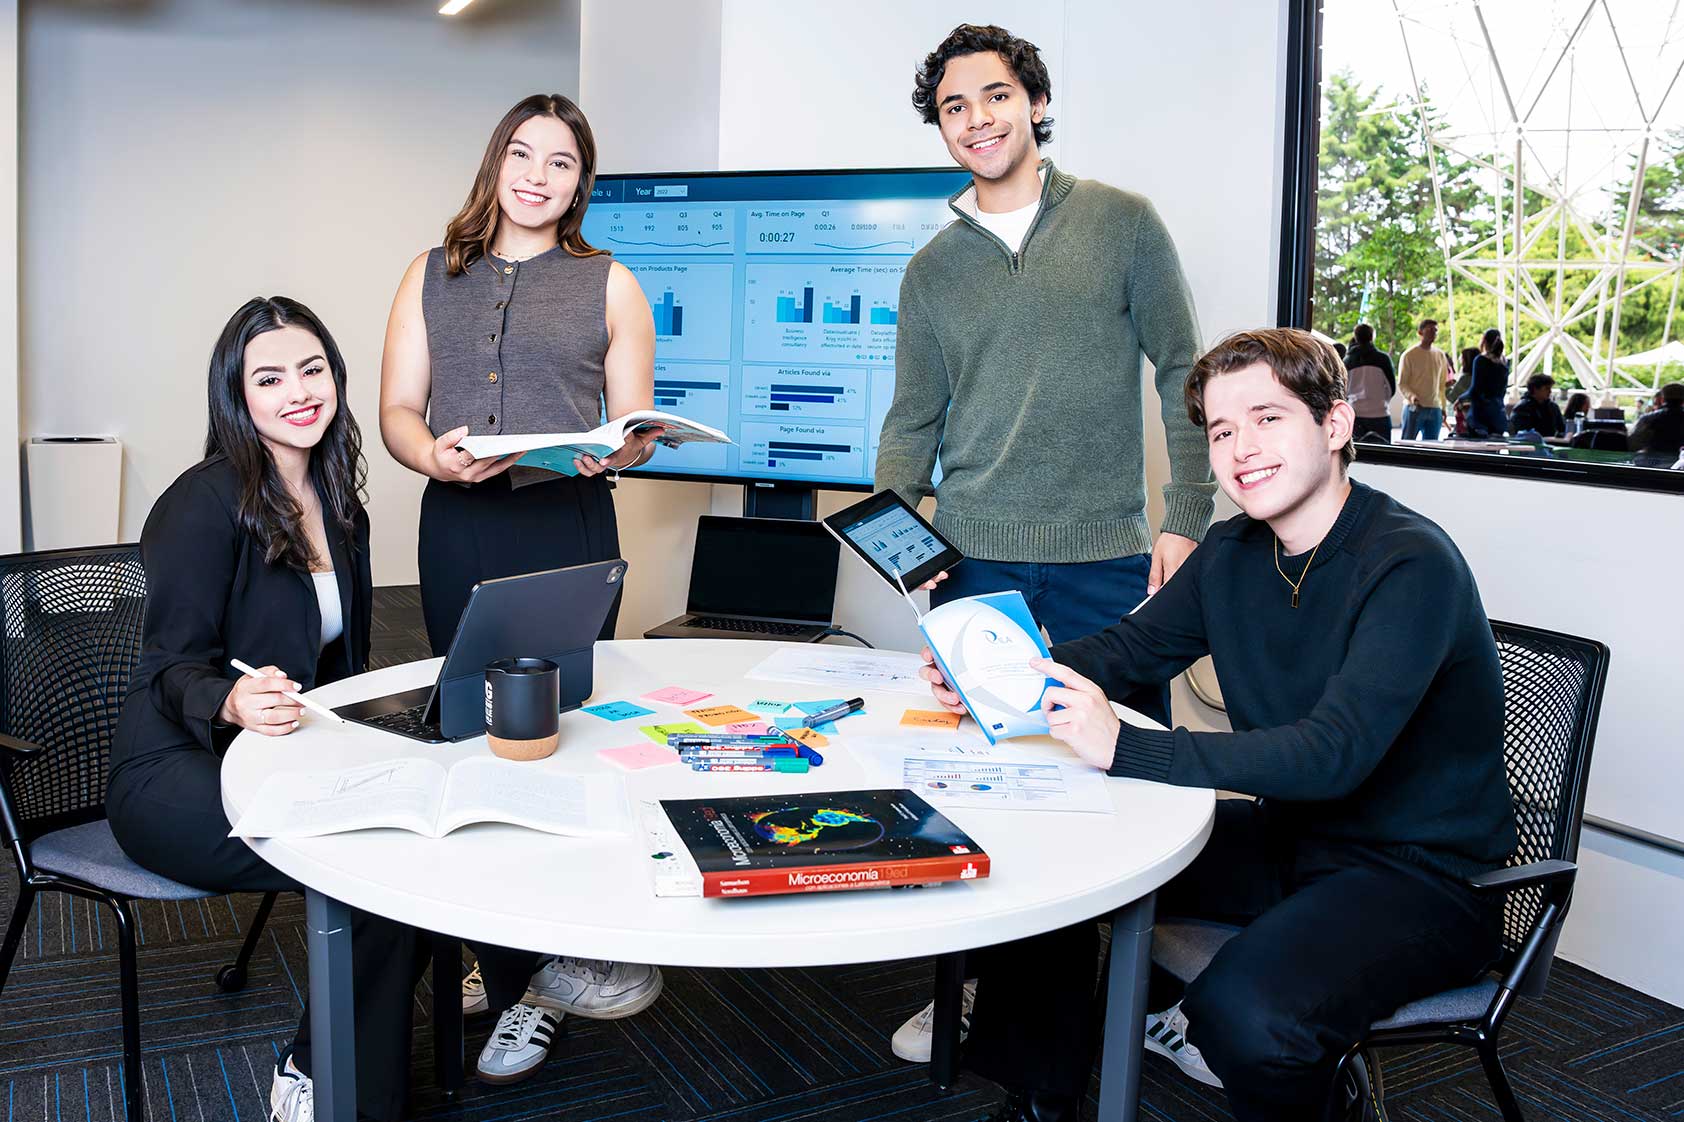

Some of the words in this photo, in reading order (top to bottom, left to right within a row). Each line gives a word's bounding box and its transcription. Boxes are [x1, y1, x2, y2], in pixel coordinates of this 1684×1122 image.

[636, 187, 652, 196] Year
[759, 233, 795, 242] 0:00:27
[788, 869, 878, 886] Microeconomía
